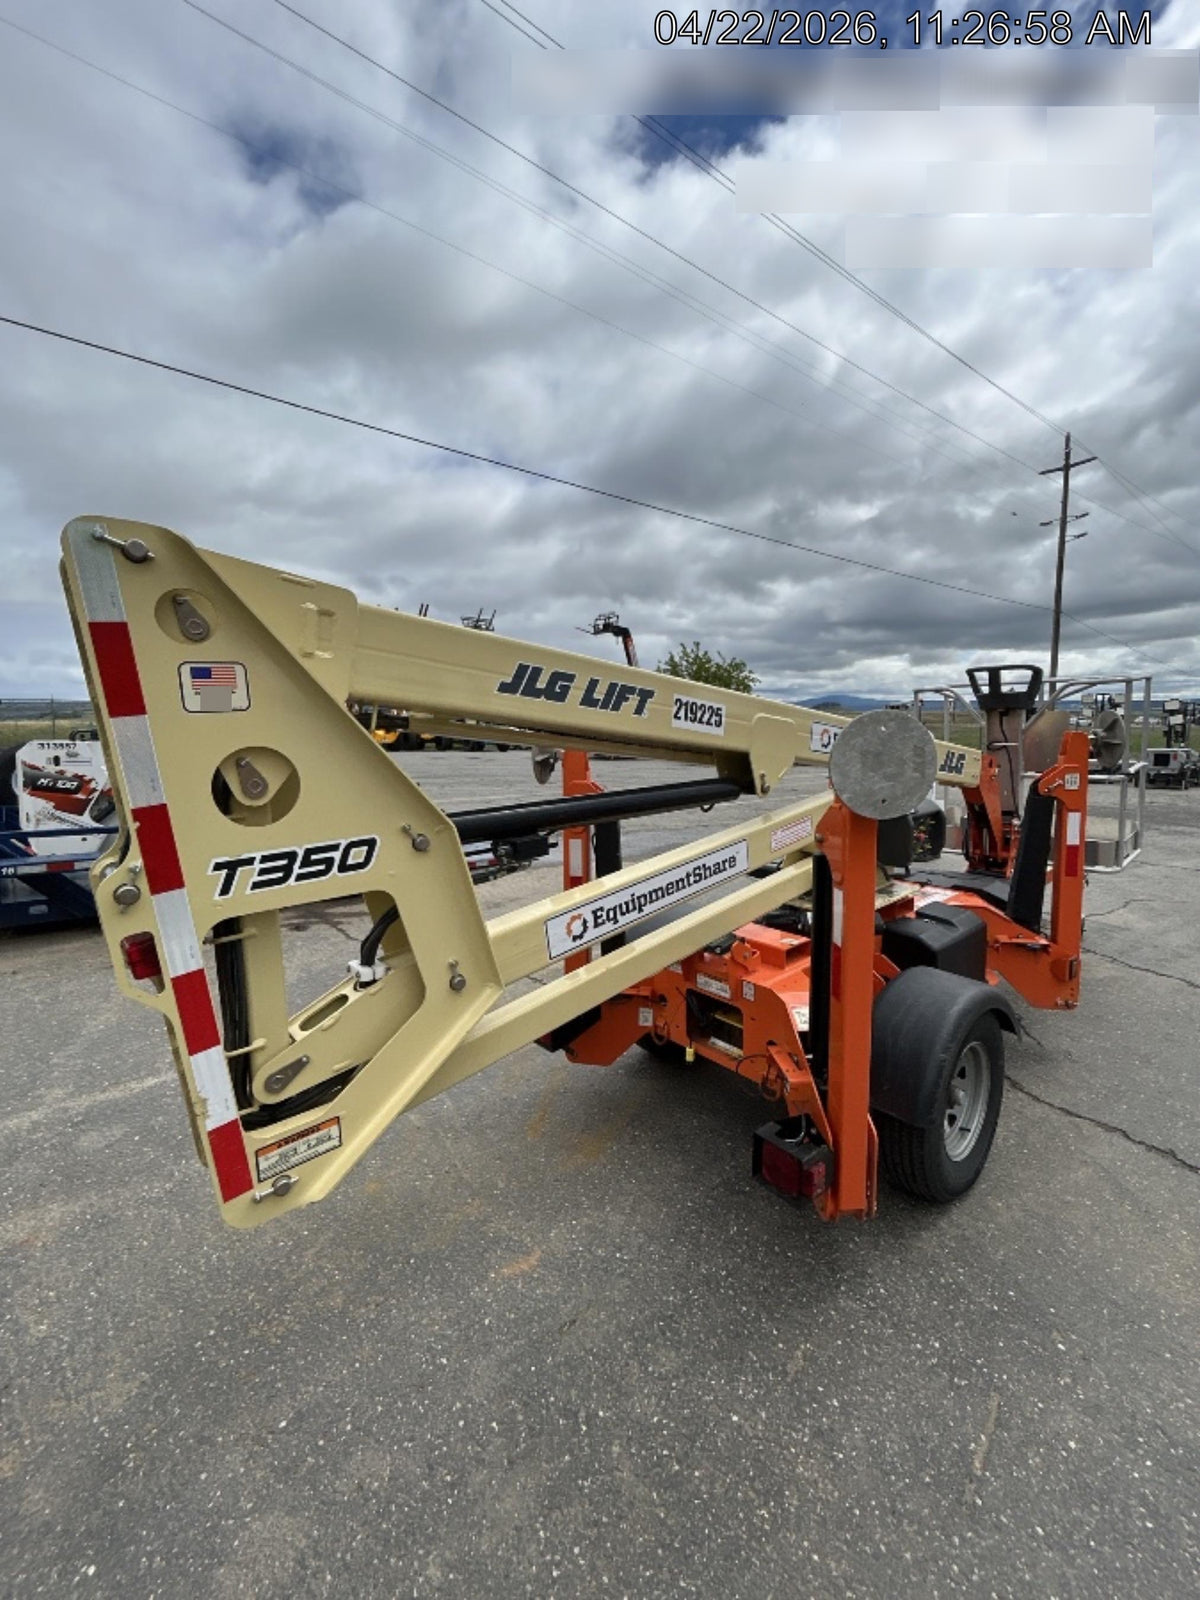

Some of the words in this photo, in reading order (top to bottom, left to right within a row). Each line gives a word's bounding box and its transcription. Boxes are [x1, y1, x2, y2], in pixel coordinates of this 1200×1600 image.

[497, 662, 576, 703] JLG
[579, 677, 656, 716] LIFT
[673, 699, 723, 728] 219225
[939, 749, 966, 775] JLG
[211, 836, 378, 898] T350
[592, 854, 736, 928] EquipmentShare
